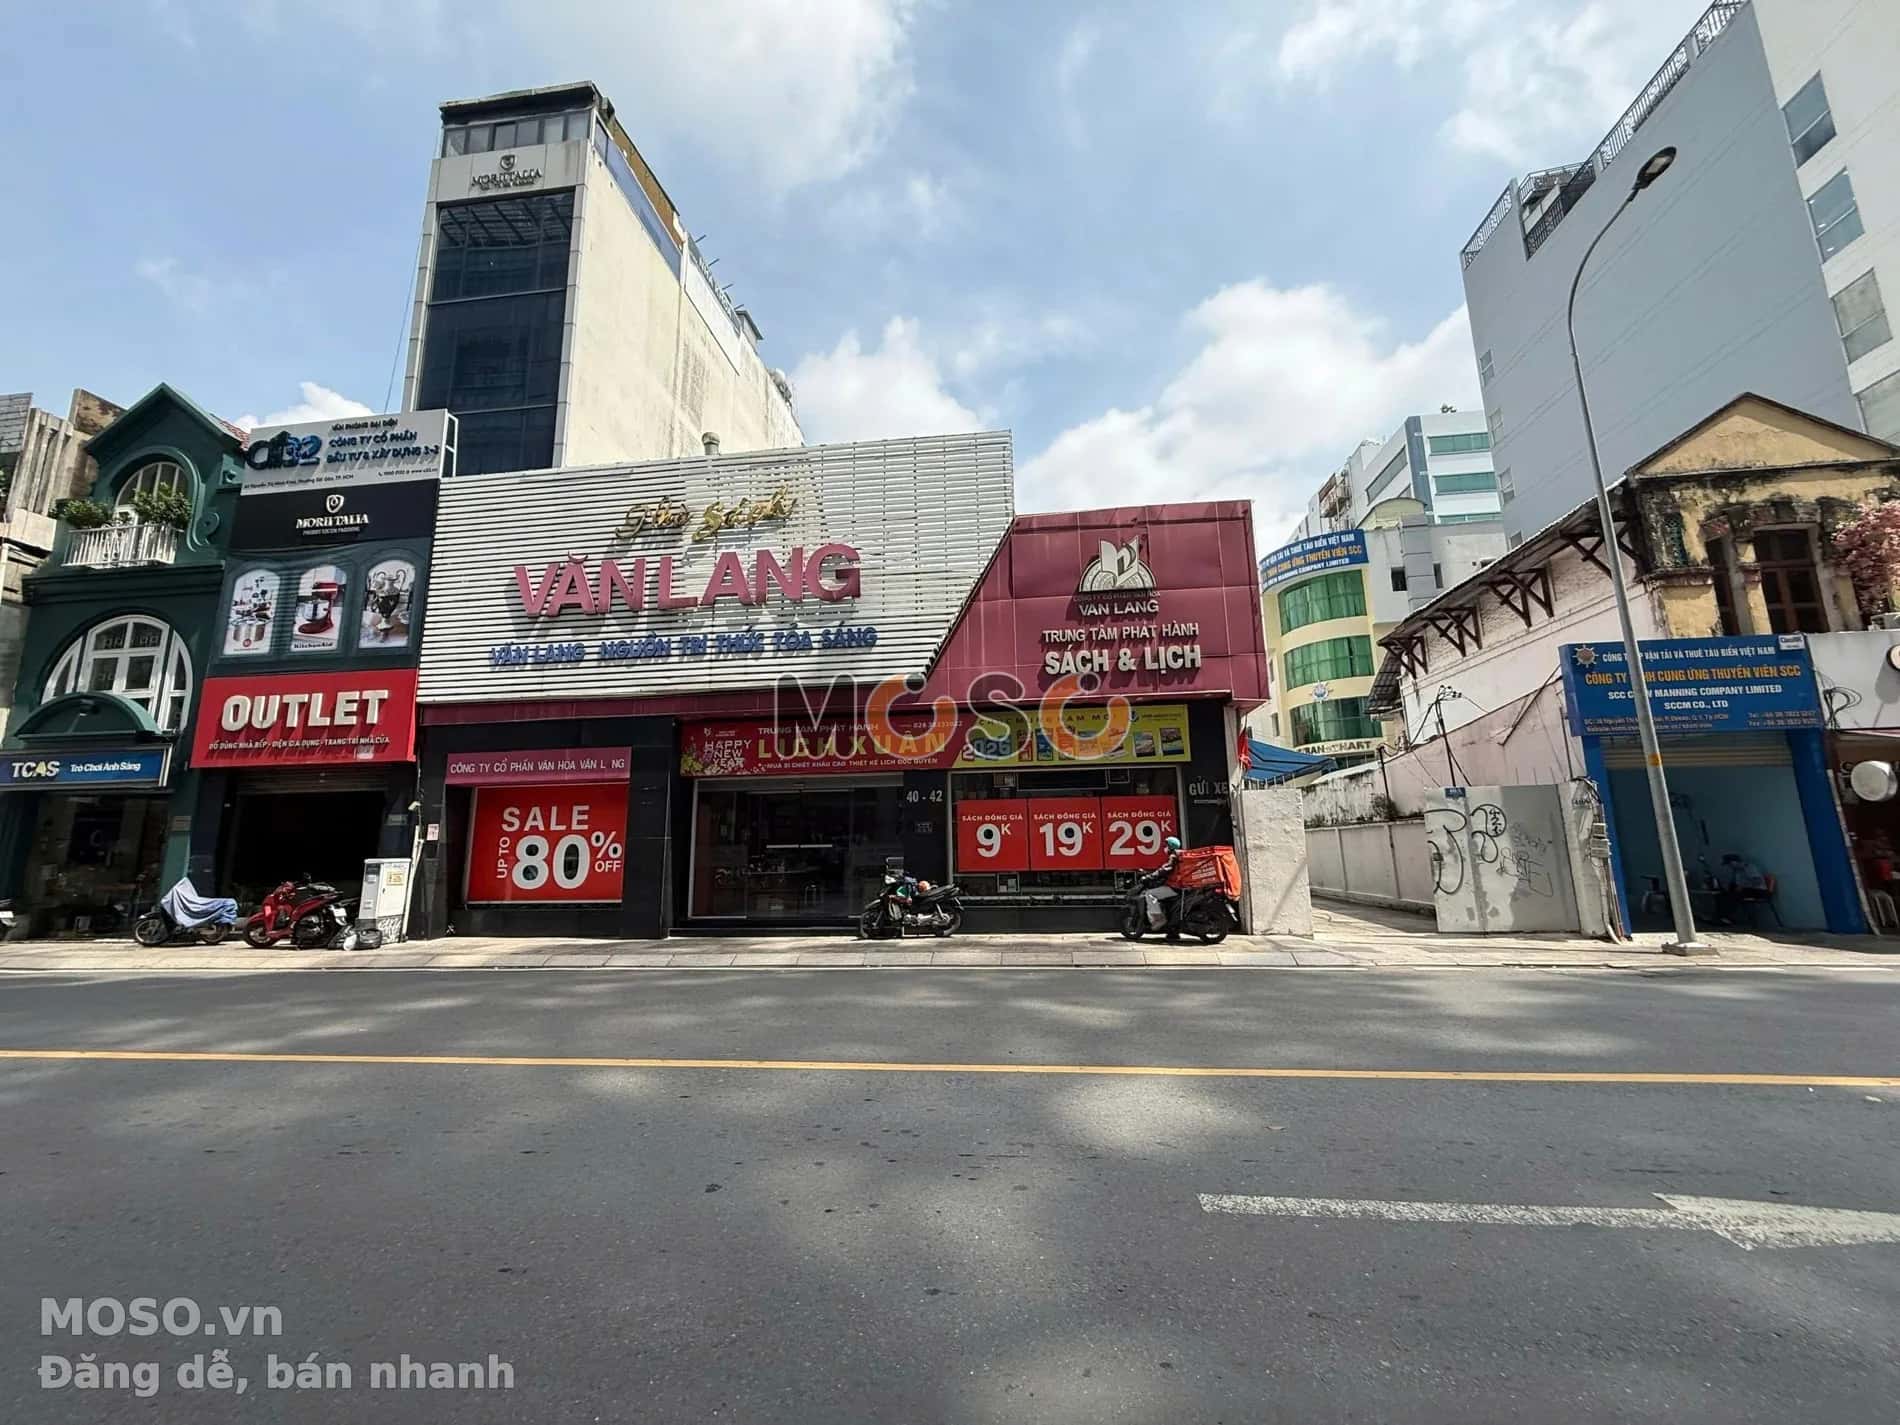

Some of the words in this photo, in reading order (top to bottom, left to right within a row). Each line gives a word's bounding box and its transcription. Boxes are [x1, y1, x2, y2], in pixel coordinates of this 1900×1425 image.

[329, 434, 357, 447] CÔNG
[359, 435, 372, 445] TY
[1341, 533, 1355, 543] NAM
[1348, 545, 1362, 554] SCC
[656, 543, 862, 611] LANG
[1113, 600, 1160, 615] LANG
[1043, 629, 1086, 644] TRUNG
[1090, 625, 1118, 641] TÂM
[1122, 621, 1157, 639] PHÁT
[1162, 620, 1200, 637] HÀNH
[490, 640, 529, 665] VĂN
[533, 642, 586, 663] LANG
[599, 630, 672, 659] NGUỒN
[821, 620, 879, 649] SÁNG
[1045, 644, 1110, 675] SÁCH
[1118, 648, 1137, 672] &
[1145, 645, 1201, 674] LỊCH
[1602, 651, 1623, 662] CÔNG
[1661, 648, 1673, 660] TẢI
[1674, 647, 1684, 659] VÀ
[1739, 646, 1756, 657] VIỆT
[1757, 646, 1776, 655] NAM
[1585, 671, 1613, 685] CÔNG
[1615, 672, 1627, 683] TY
[1657, 670, 1685, 682] CUNG
[1687, 667, 1710, 681] ỨNG
[1710, 664, 1751, 680] THUYỀN
[1752, 664, 1778, 678] VIÊN
[1779, 665, 1801, 677] SCC
[1607, 691, 1626, 700] SCC
[1655, 687, 1698, 697] MANNING
[1699, 686, 1744, 696] COMPANY
[1745, 684, 1783, 694] LIMITED
[221, 689, 389, 731] OUTLET
[1664, 701, 1692, 710] SCCM
[1711, 700, 1729, 709] LTD
[758, 727, 792, 735] TRUNG
[324, 738, 346, 746] TRANG
[704, 739, 753, 750] HAPPY
[712, 749, 743, 759] NEW
[12, 761, 60, 778] TCAS
[450, 760, 476, 774] CÔNG
[478, 762, 491, 773] TY
[493, 757, 508, 772] CỔ
[712, 758, 745, 768] YEAR
[1213, 781, 1229, 794] XE
[906, 790, 919, 802] 40
[929, 790, 943, 802] 42
[502, 804, 590, 832] SALE
[962, 813, 982, 821] SÁCH
[1010, 811, 1023, 821] GIÁ
[1033, 812, 1054, 820] SÁCH
[1082, 810, 1097, 819] GIÁ
[1107, 810, 1129, 819] SÁCH
[1157, 808, 1172, 818] GIÁ
[976, 823, 1012, 858] 9K
[1039, 821, 1094, 857] 19K
[1108, 820, 1173, 857] 29K
[498, 836, 511, 857] TO
[496, 858, 508, 879] UP
[594, 860, 622, 873] OFF
